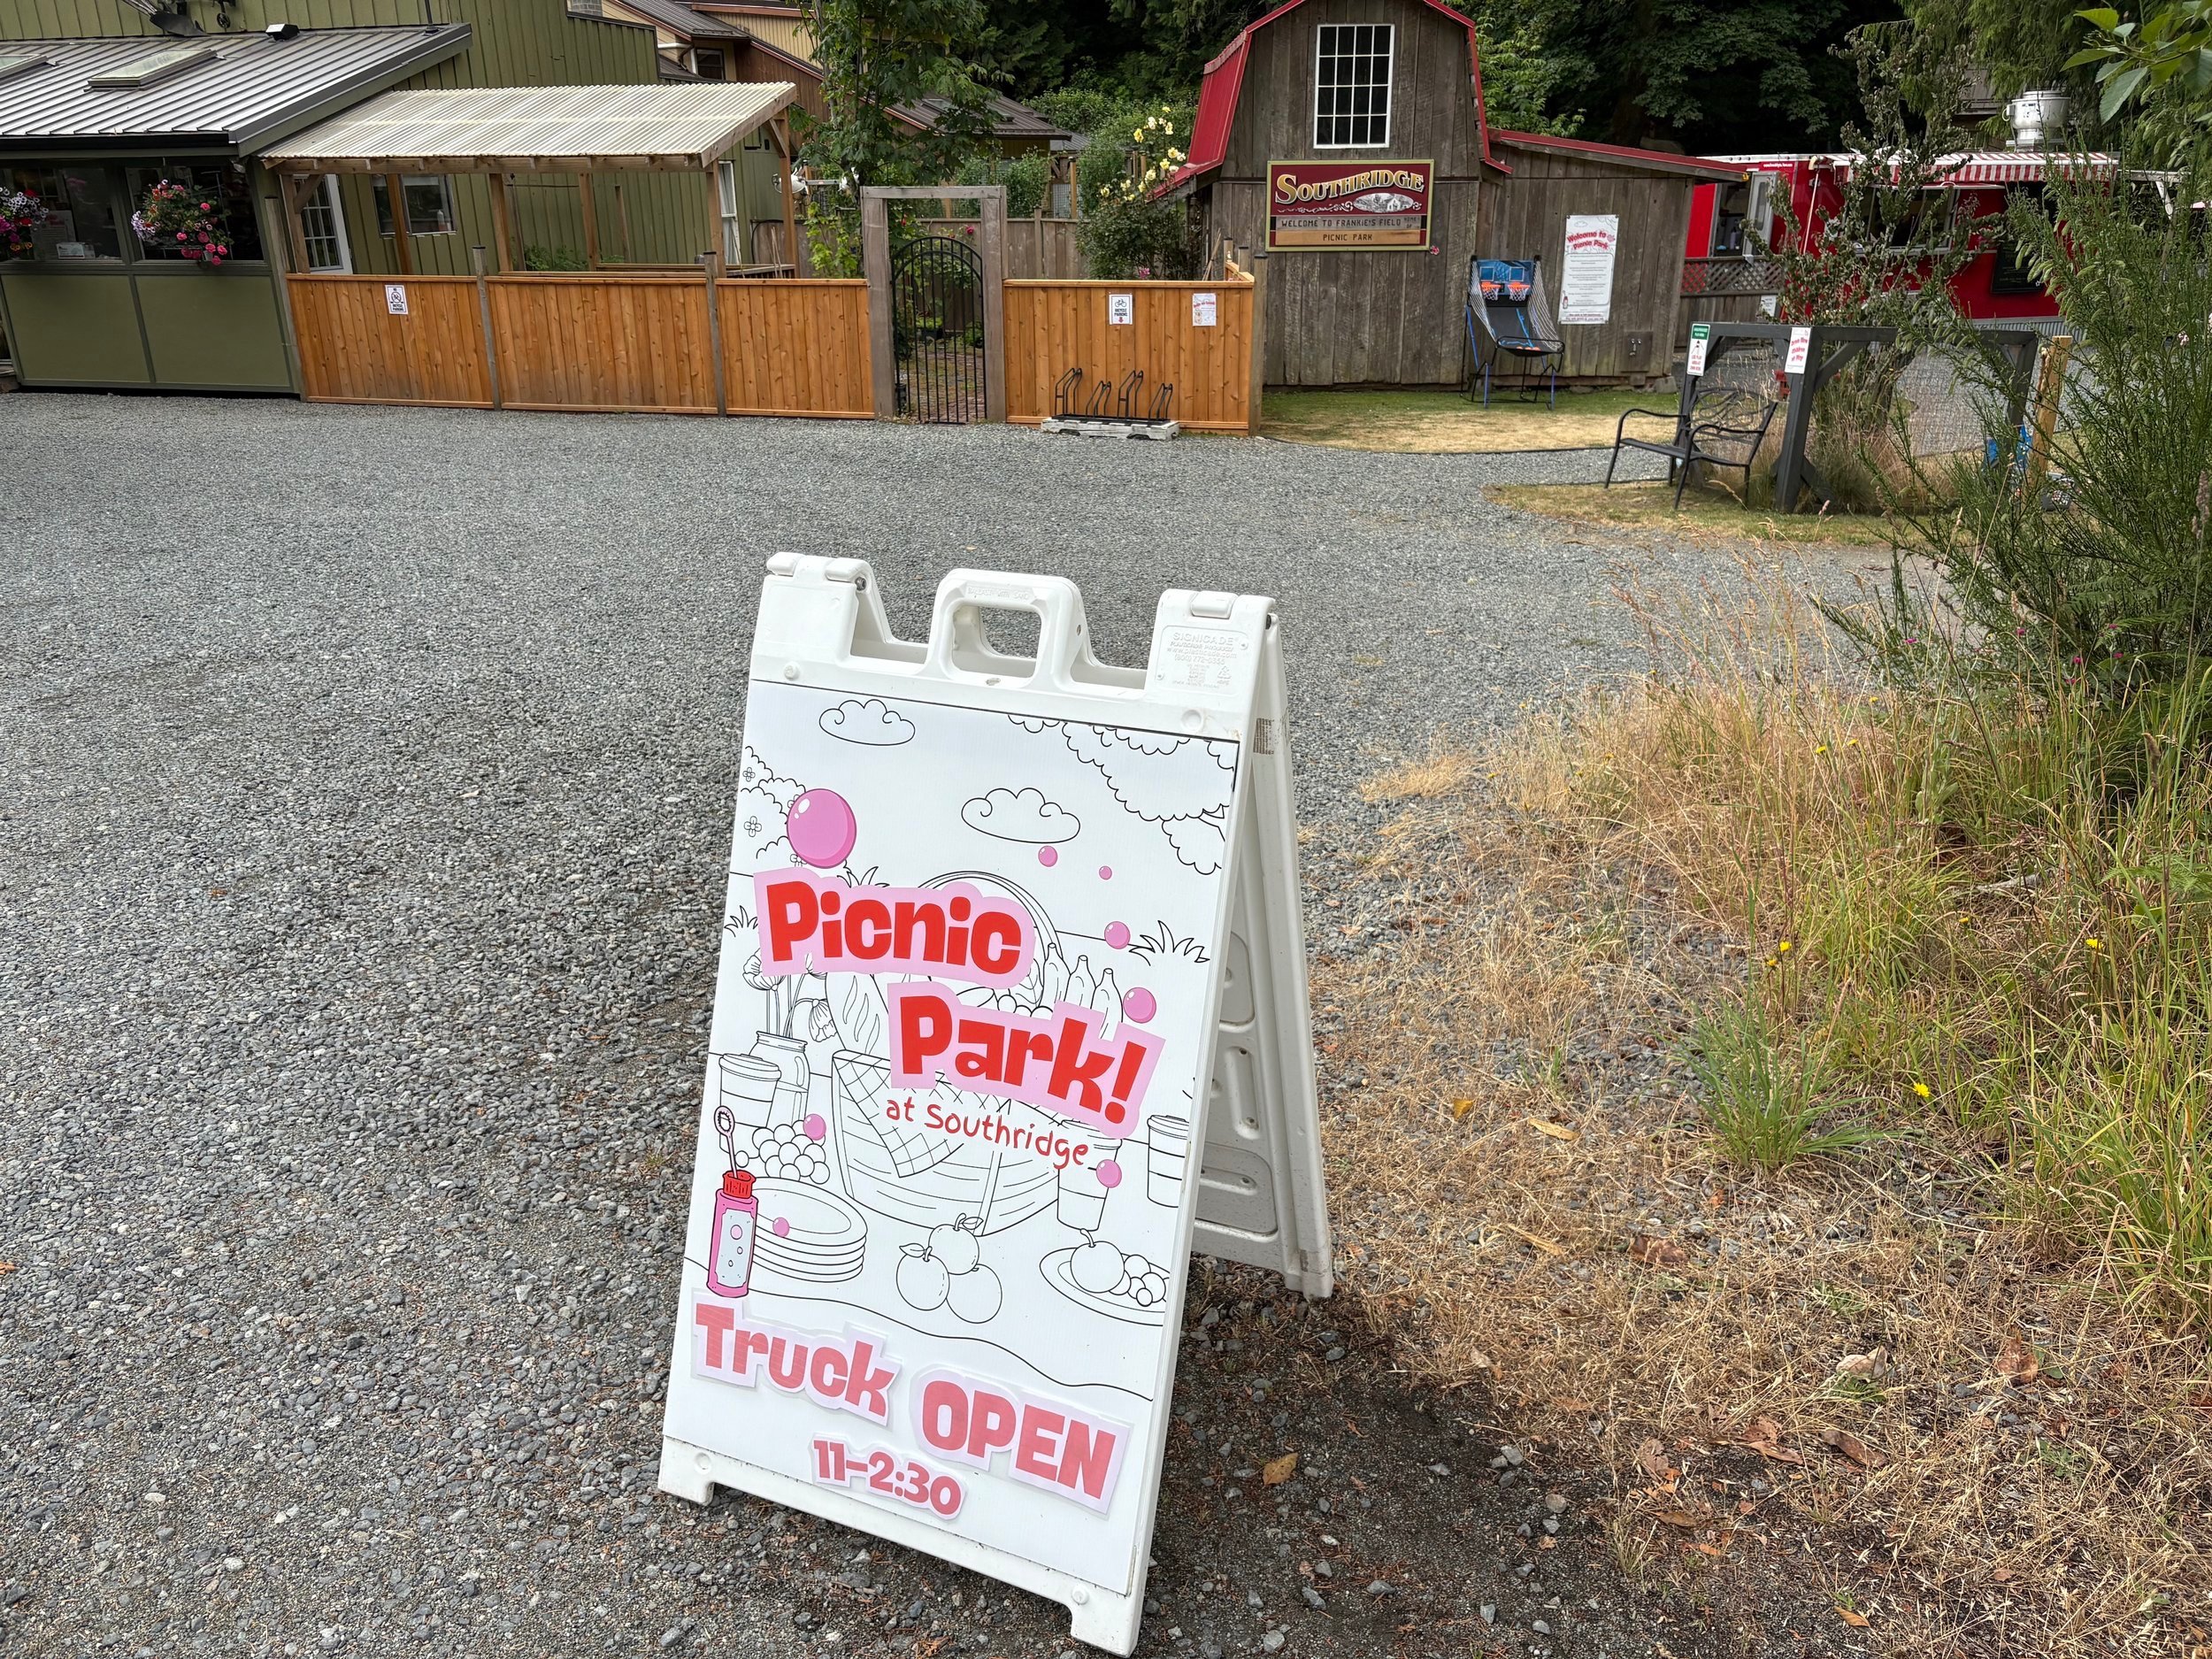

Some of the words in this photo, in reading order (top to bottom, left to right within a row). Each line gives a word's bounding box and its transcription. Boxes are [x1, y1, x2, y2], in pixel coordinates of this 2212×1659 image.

[1275, 169, 1425, 204] SOUTHRIDGE
[1379, 218, 1401, 227] FIELD
[1353, 233, 1372, 242] PARK
[1567, 232, 1597, 242] Welcome
[1594, 239, 1609, 250] Park
[1172, 632, 1234, 646] SIGNICADE
[767, 882, 1022, 974] Picnic
[900, 995, 1147, 1125] Park!
[886, 1095, 916, 1122] at
[924, 1103, 1089, 1170] Southridge
[695, 1302, 895, 1417] Truck
[922, 1379, 1117, 1501] OPEN
